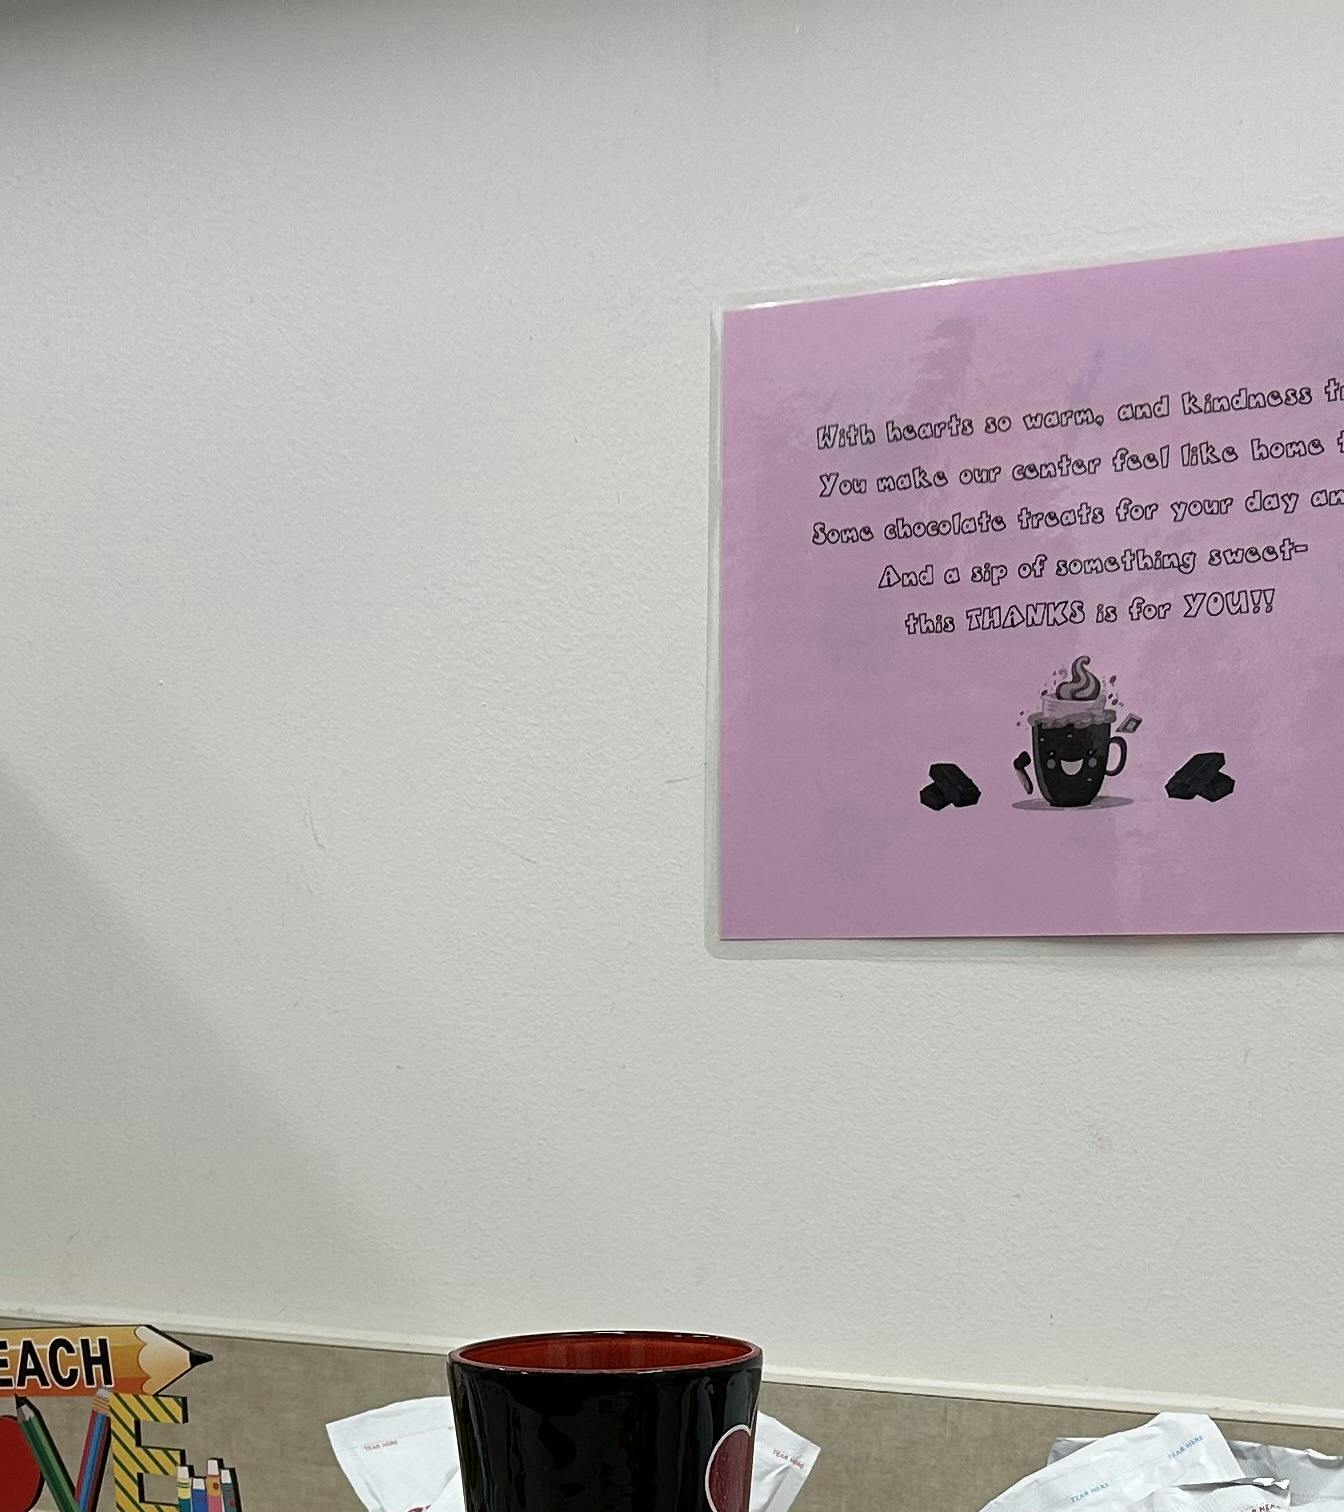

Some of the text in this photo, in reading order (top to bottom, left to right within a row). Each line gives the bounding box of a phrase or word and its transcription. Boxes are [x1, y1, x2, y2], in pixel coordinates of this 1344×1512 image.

[817, 423, 875, 450] With
[886, 413, 974, 443] hearts
[984, 416, 1012, 434] so
[1022, 408, 1104, 431] warm,
[1117, 394, 1169, 422] and
[1182, 385, 1312, 415] kindness
[819, 472, 867, 498] You
[876, 466, 948, 492] make
[959, 466, 1001, 485] our
[1012, 453, 1101, 481] center
[1112, 444, 1170, 472] feel
[1181, 440, 1239, 467] like
[1250, 438, 1325, 461] home
[812, 521, 874, 545] Some
[884, 509, 1006, 540] chocolate
[1017, 502, 1104, 530] treats
[1116, 497, 1159, 523] for
[1170, 497, 1234, 523] your
[1245, 489, 1299, 514] day
[878, 537, 1308, 589] And a sip of something sweet-
[905, 588, 1275, 635] this THANKS is for YOU!!
